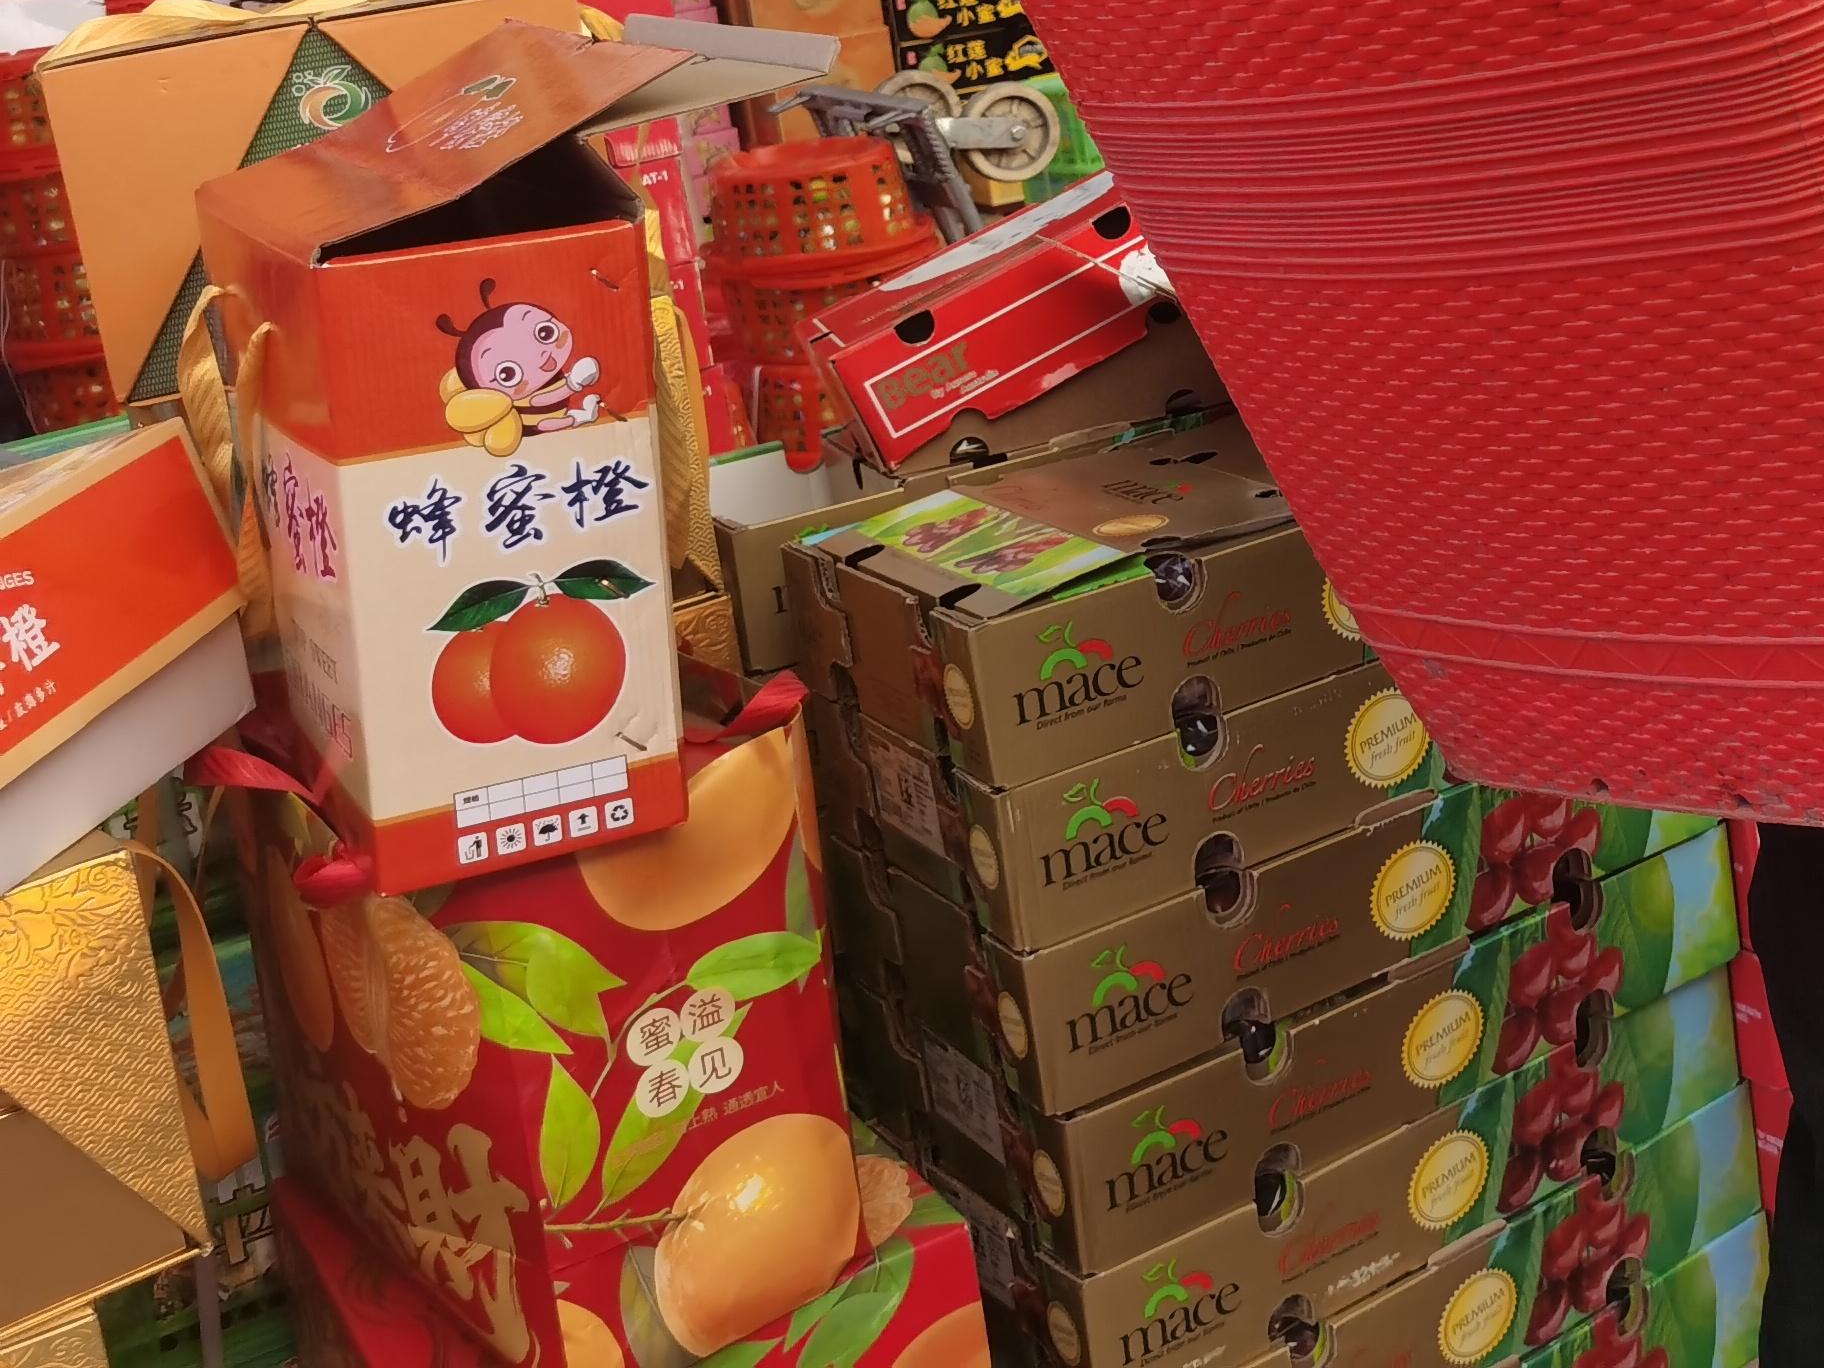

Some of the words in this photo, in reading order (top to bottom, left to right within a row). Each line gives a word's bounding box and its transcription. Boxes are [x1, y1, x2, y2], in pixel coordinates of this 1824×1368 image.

[642, 170, 669, 185] AT-1
[877, 341, 967, 411] Bear
[388, 461, 651, 562] 蜂蜜橙
[1183, 591, 1292, 659] Cherries
[1013, 655, 1144, 726] mace
[1037, 715, 1062, 730] Direct
[1064, 706, 1086, 722] from
[1087, 700, 1102, 713] our
[1360, 712, 1416, 754] PREMIUM
[1208, 744, 1317, 811] Cherries
[1040, 813, 1170, 887] mace
[1386, 864, 1442, 908] PREMIUM
[1234, 903, 1340, 976] Cherries
[1066, 973, 1194, 1053] mace
[1415, 1011, 1471, 1057] PREMIUM
[1105, 1130, 1230, 1212] mace
[1422, 1152, 1478, 1199] PREMIUM
[1120, 1283, 1242, 1366] mace
[1452, 1287, 1505, 1336] PREMIUM
